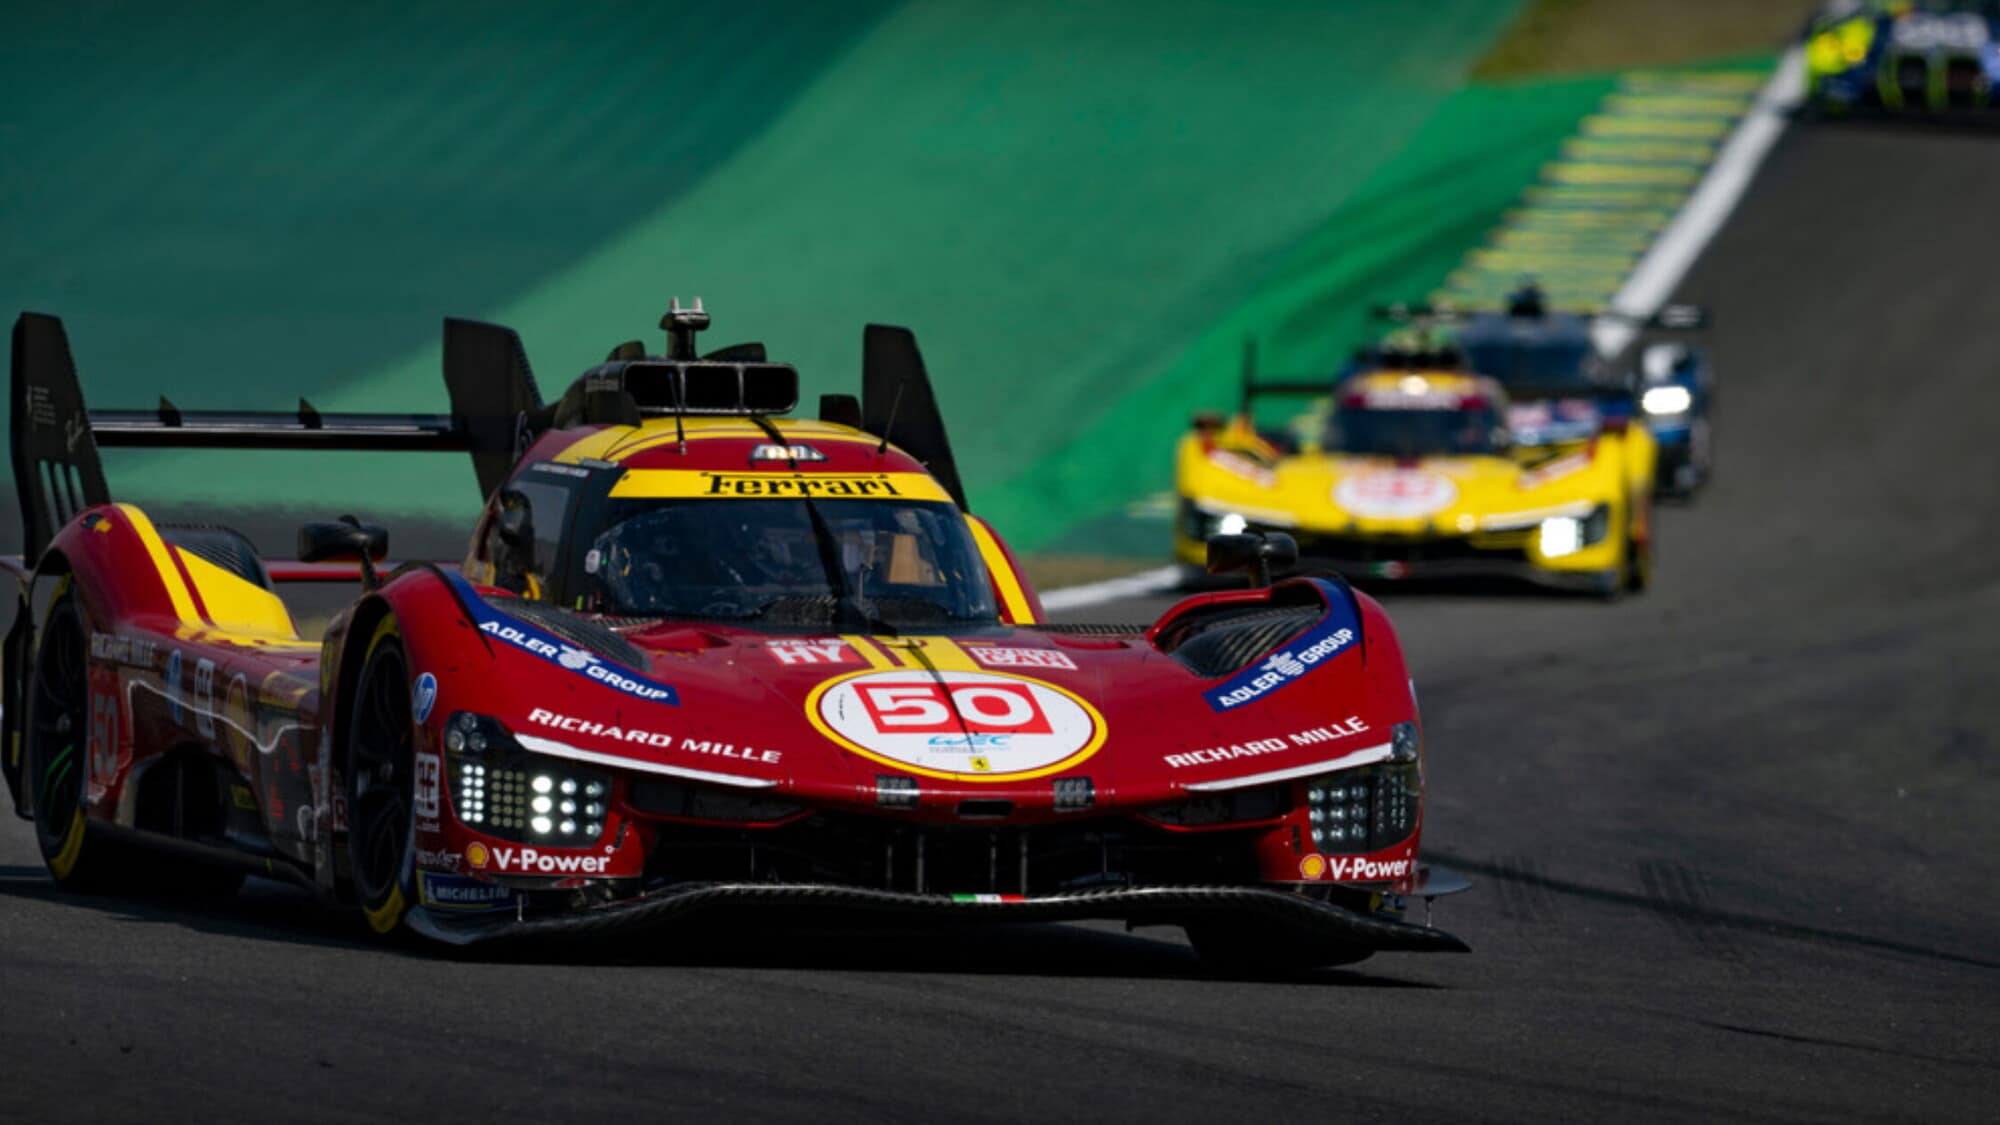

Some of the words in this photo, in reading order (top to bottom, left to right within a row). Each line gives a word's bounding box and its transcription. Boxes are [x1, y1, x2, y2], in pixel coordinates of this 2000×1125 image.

[700, 471, 902, 497] Ferrari
[478, 620, 559, 658] ADLER
[585, 665, 669, 700] GROUP
[771, 645, 843, 664] HY
[1217, 671, 1286, 708] ADLER
[1297, 627, 1354, 665] GROUP
[866, 686, 1035, 727] 50
[527, 707, 673, 748] RICHARD
[680, 737, 784, 764] MILLE
[1162, 736, 1289, 769] RICHARD
[1287, 714, 1371, 747] MILLE
[492, 847, 611, 873] V-Power
[1329, 856, 1410, 880] V-Power
[435, 886, 511, 900] MICHELIN
